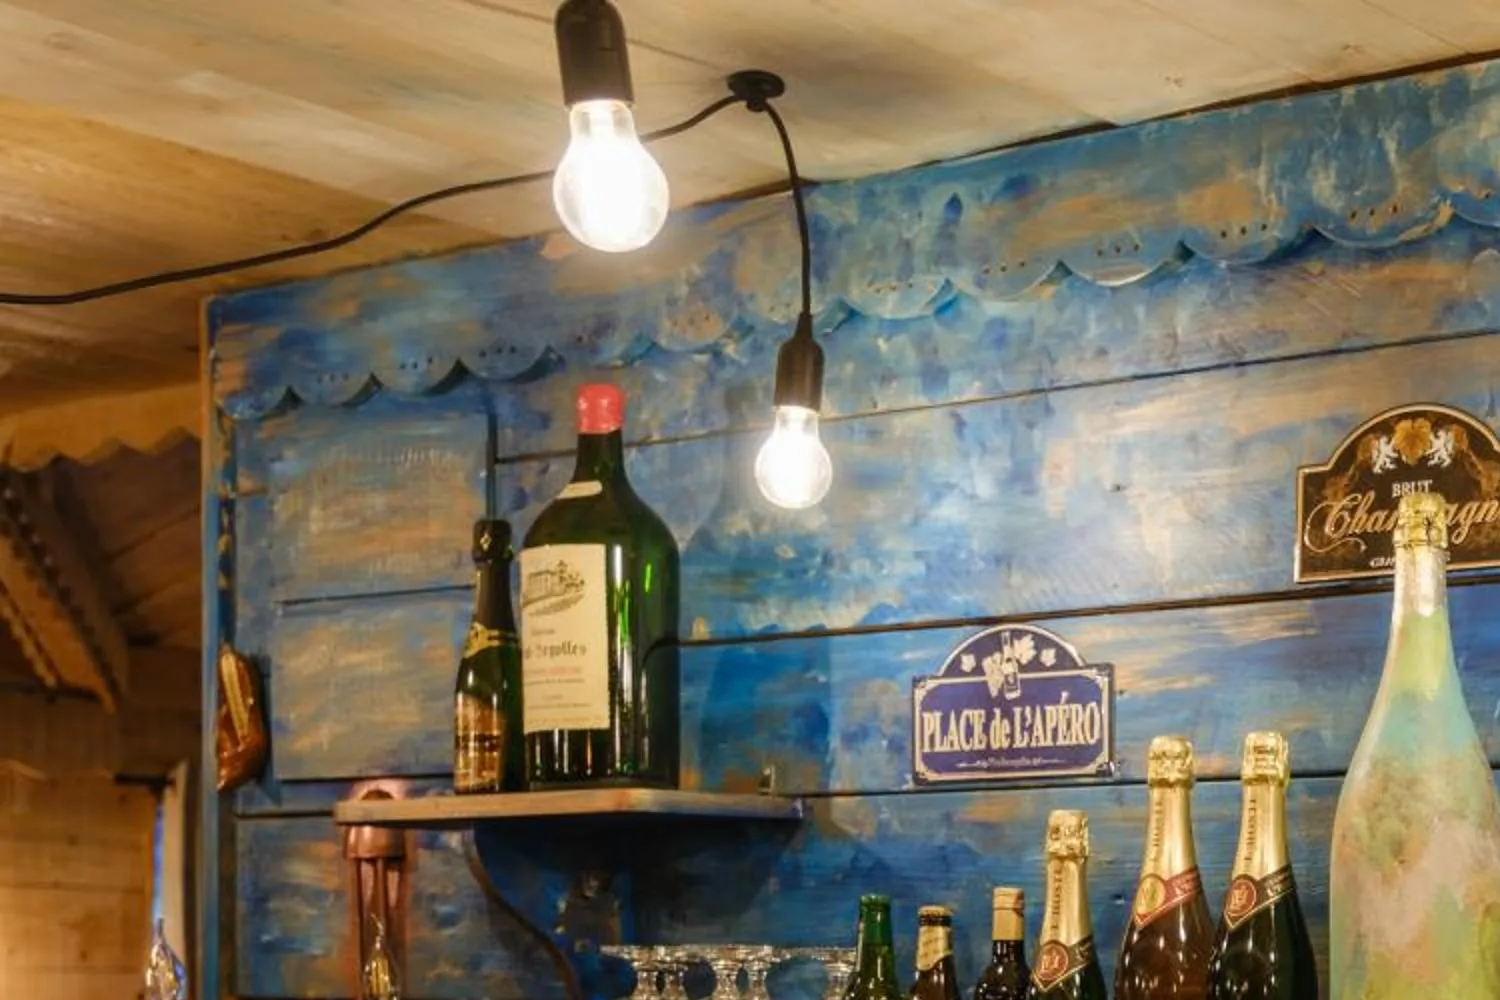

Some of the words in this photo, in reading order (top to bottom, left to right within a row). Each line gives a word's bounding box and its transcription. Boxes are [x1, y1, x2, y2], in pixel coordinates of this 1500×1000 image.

[1392, 480, 1433, 498] BRUT
[921, 709, 987, 753] PLACE
[989, 708, 1011, 750] de
[1012, 692, 1101, 749] L'APÉRO
